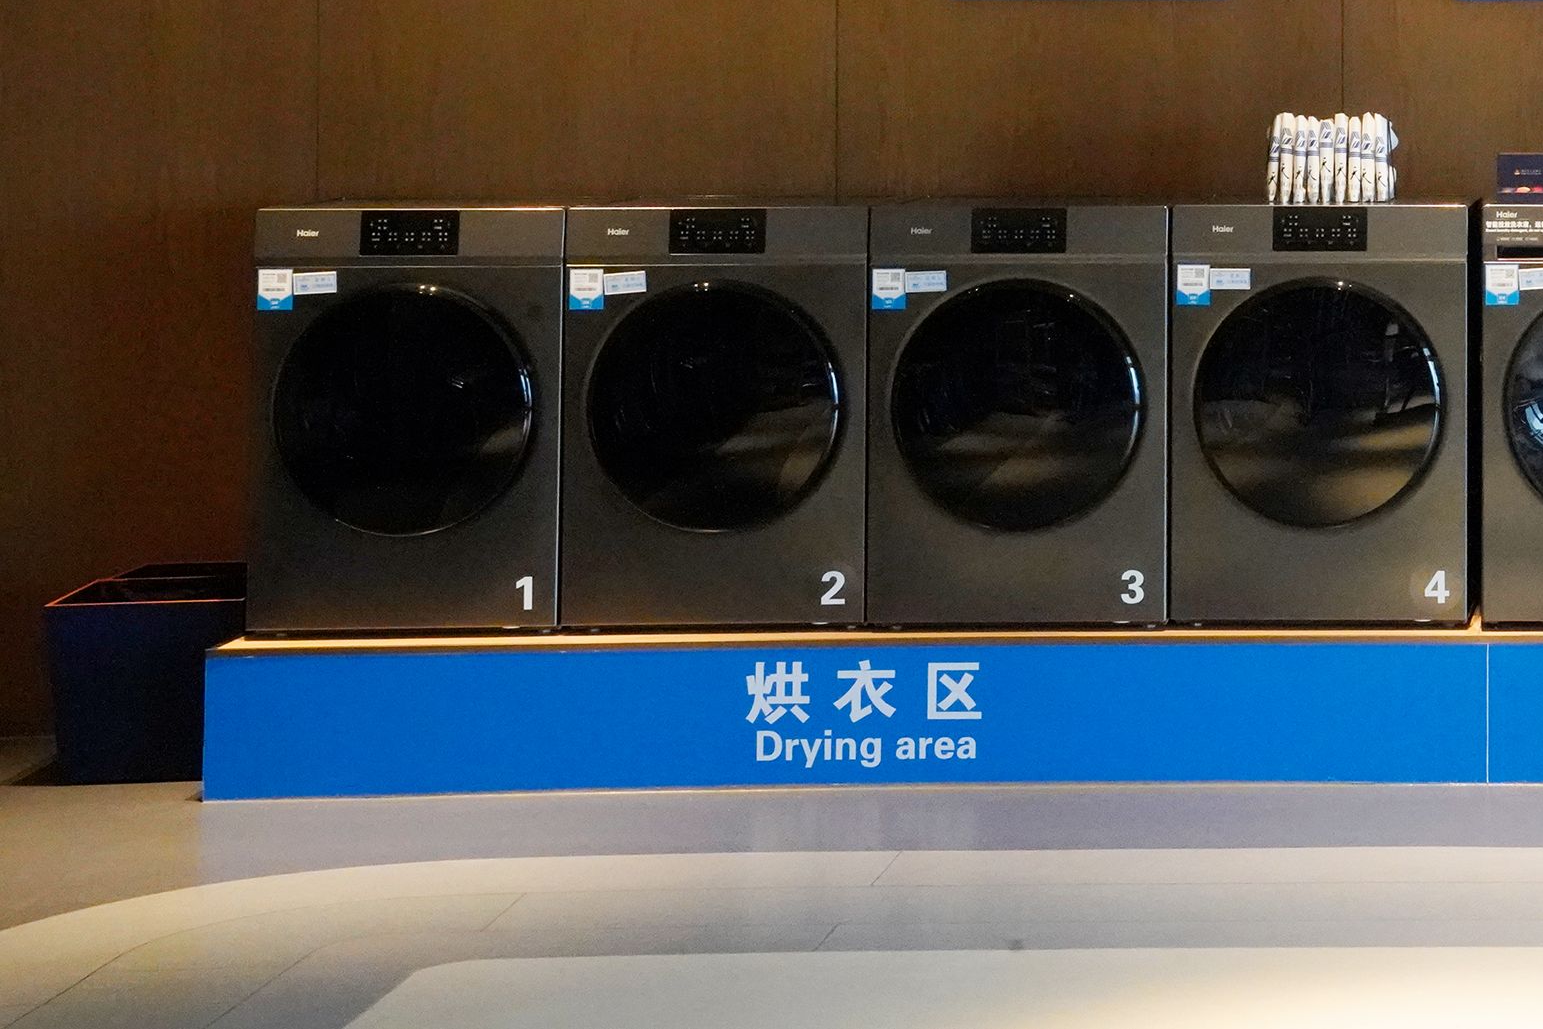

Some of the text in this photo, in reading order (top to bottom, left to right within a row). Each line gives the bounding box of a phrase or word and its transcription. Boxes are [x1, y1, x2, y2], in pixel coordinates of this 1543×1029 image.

[608, 227, 630, 236] Haier
[910, 227, 933, 235] Haier
[1212, 225, 1235, 233] Haier
[1496, 210, 1518, 219] Haier
[297, 229, 320, 237] Haier
[515, 576, 533, 611] 1
[820, 570, 845, 606] 2
[1120, 569, 1145, 605] 3
[1424, 570, 1450, 604] 4
[745, 660, 982, 724] 烘衣区
[756, 730, 977, 768] Drying area
